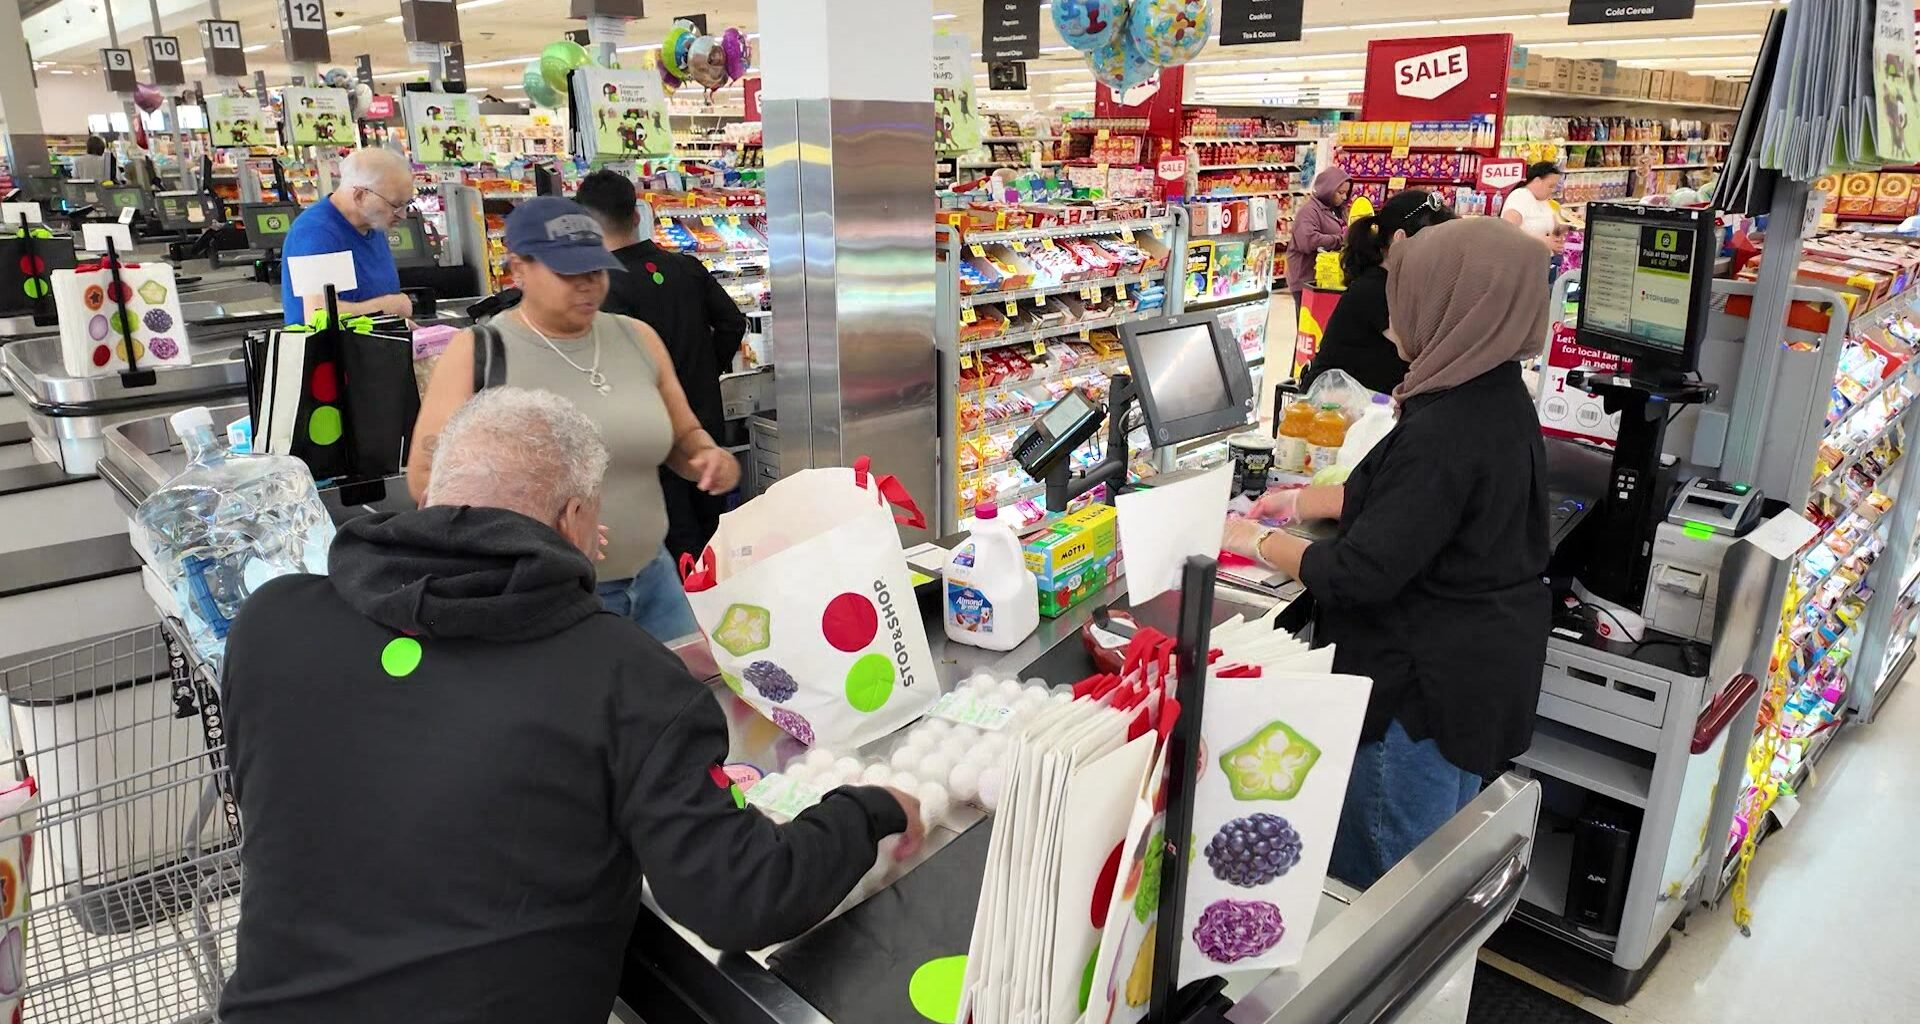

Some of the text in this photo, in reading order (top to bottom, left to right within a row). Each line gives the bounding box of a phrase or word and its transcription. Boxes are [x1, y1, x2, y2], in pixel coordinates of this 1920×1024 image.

[293, 3, 321, 23] 12
[1605, 6, 1654, 16] Cold Cereal
[214, 26, 235, 42] 11
[1242, 31, 1252, 39] Tea
[154, 41, 176, 56] 10
[114, 53, 125, 66] 9
[1400, 53, 1463, 86] SALE
[1161, 163, 1182, 173] SALE
[1485, 165, 1520, 178] SALE
[1562, 345, 1577, 354] for
[1578, 347, 1601, 358] local
[1581, 358, 1618, 370] in need
[956, 597, 983, 606] Almond
[873, 579, 915, 688] STOP&SHOP
[1588, 874, 1607, 884] APC
